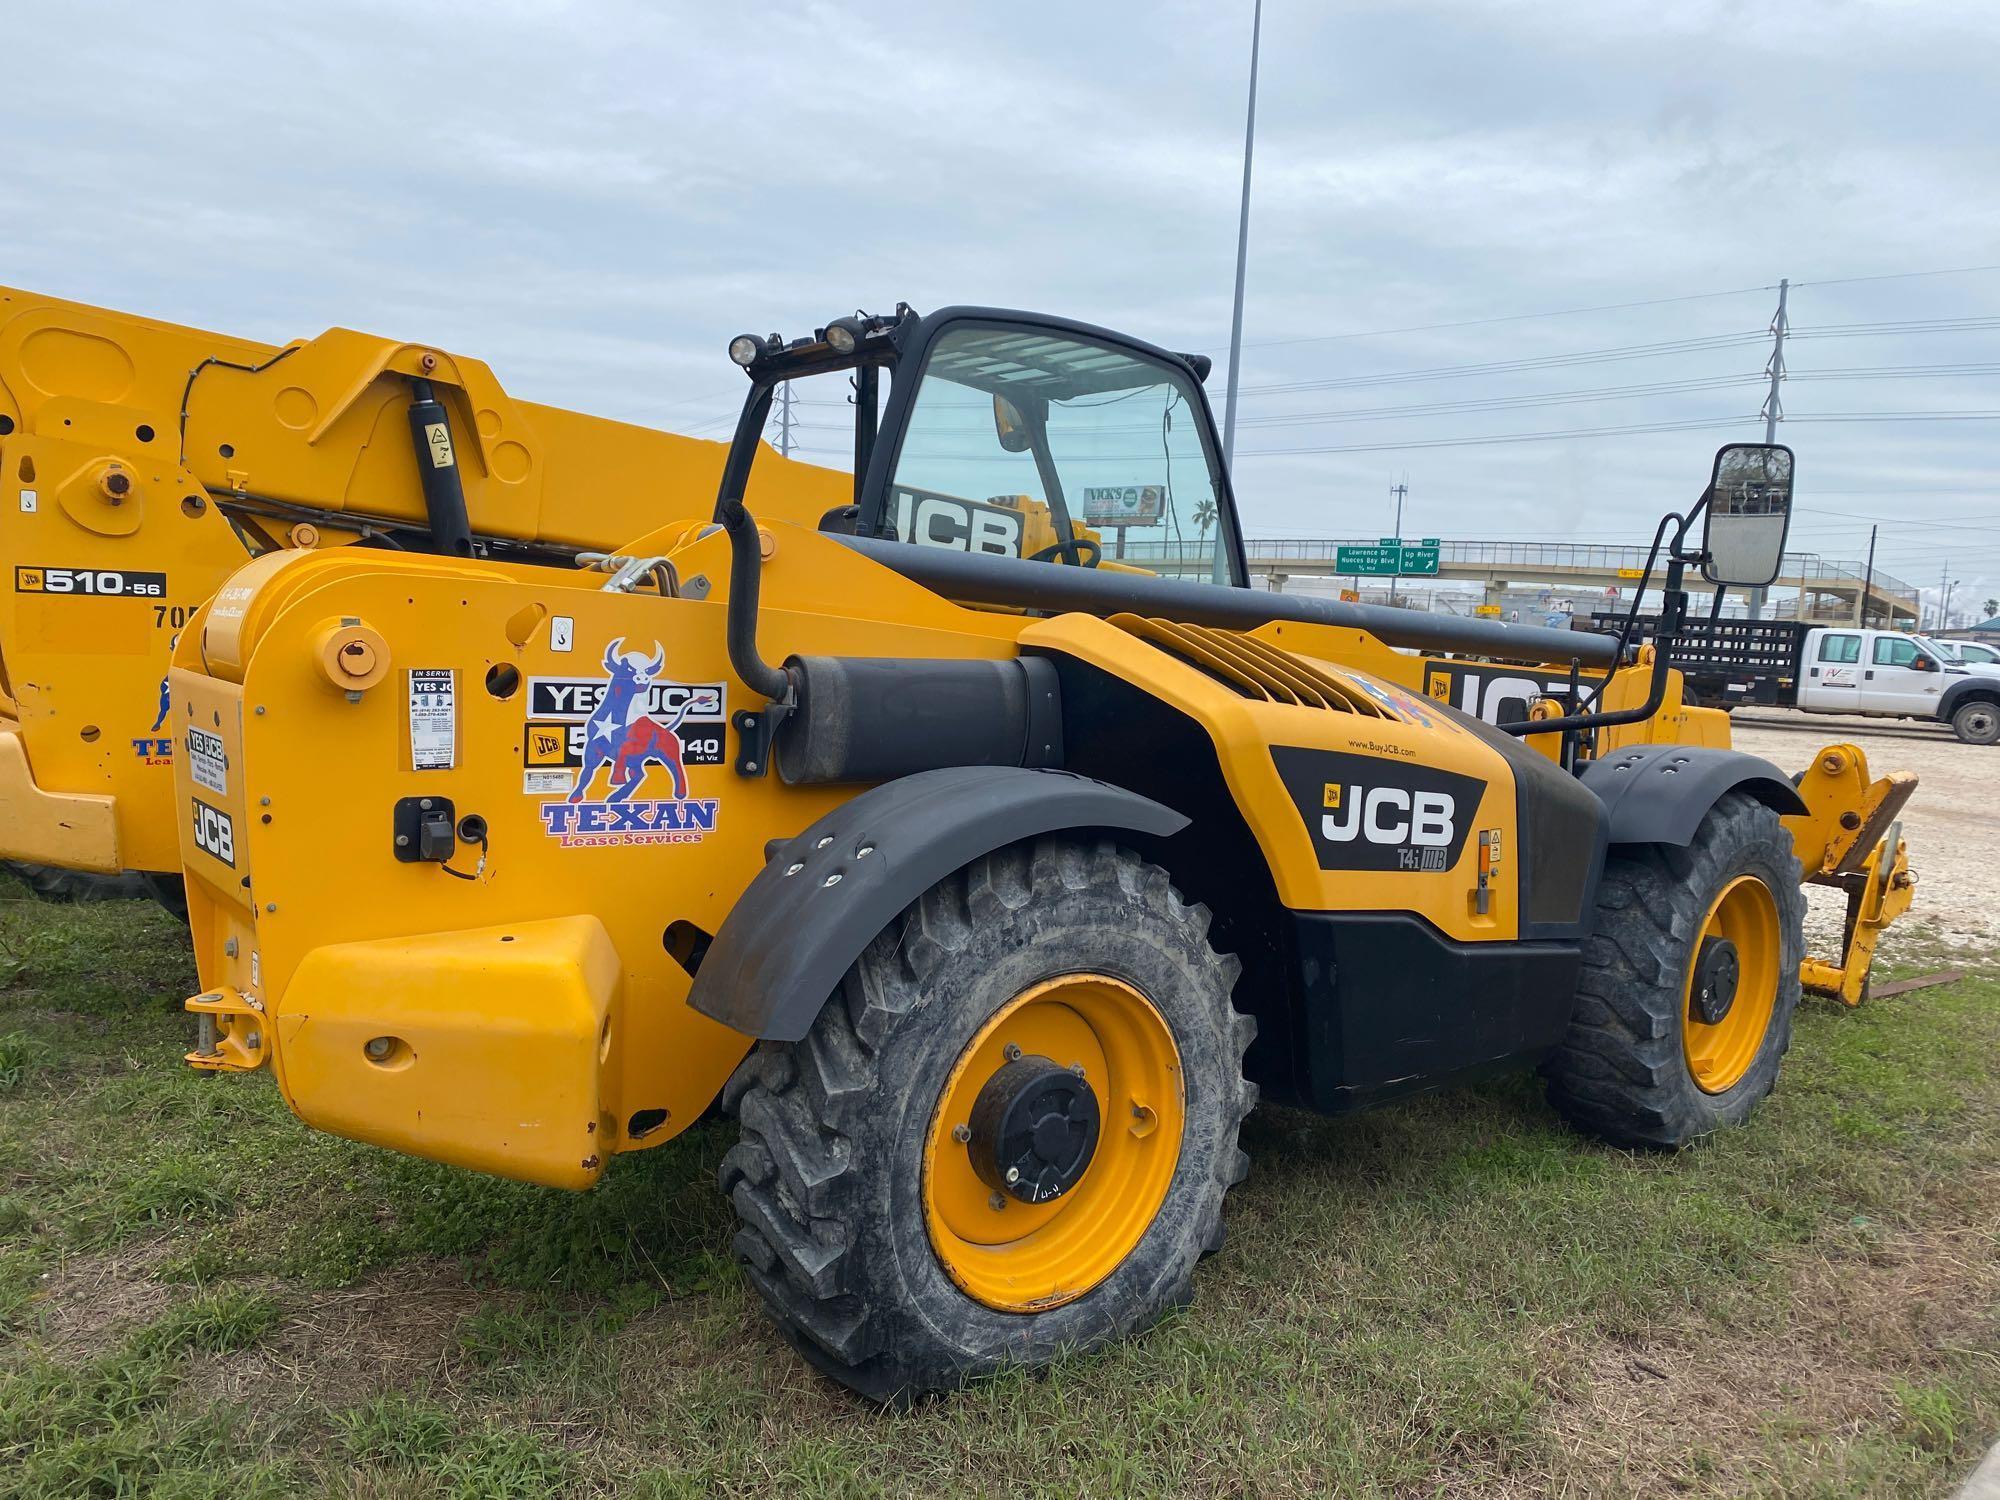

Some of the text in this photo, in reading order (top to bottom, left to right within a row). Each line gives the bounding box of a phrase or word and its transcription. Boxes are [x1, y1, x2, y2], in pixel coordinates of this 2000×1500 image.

[1366, 557, 1377, 565] Bay
[1380, 557, 1394, 565] Blvd
[1405, 551, 1414, 559] Up
[45, 569, 161, 595] 510-56
[415, 683, 436, 692] YES
[191, 732, 204, 755] YES
[537, 736, 559, 755] JCB
[1348, 739, 1416, 758] www.BuyJCB.com
[542, 800, 717, 835] TEXAN
[1322, 785, 1455, 847] JCB
[195, 804, 234, 863] JCB
[561, 832, 703, 847] Lease Services
[1398, 848, 1420, 869] T4i
